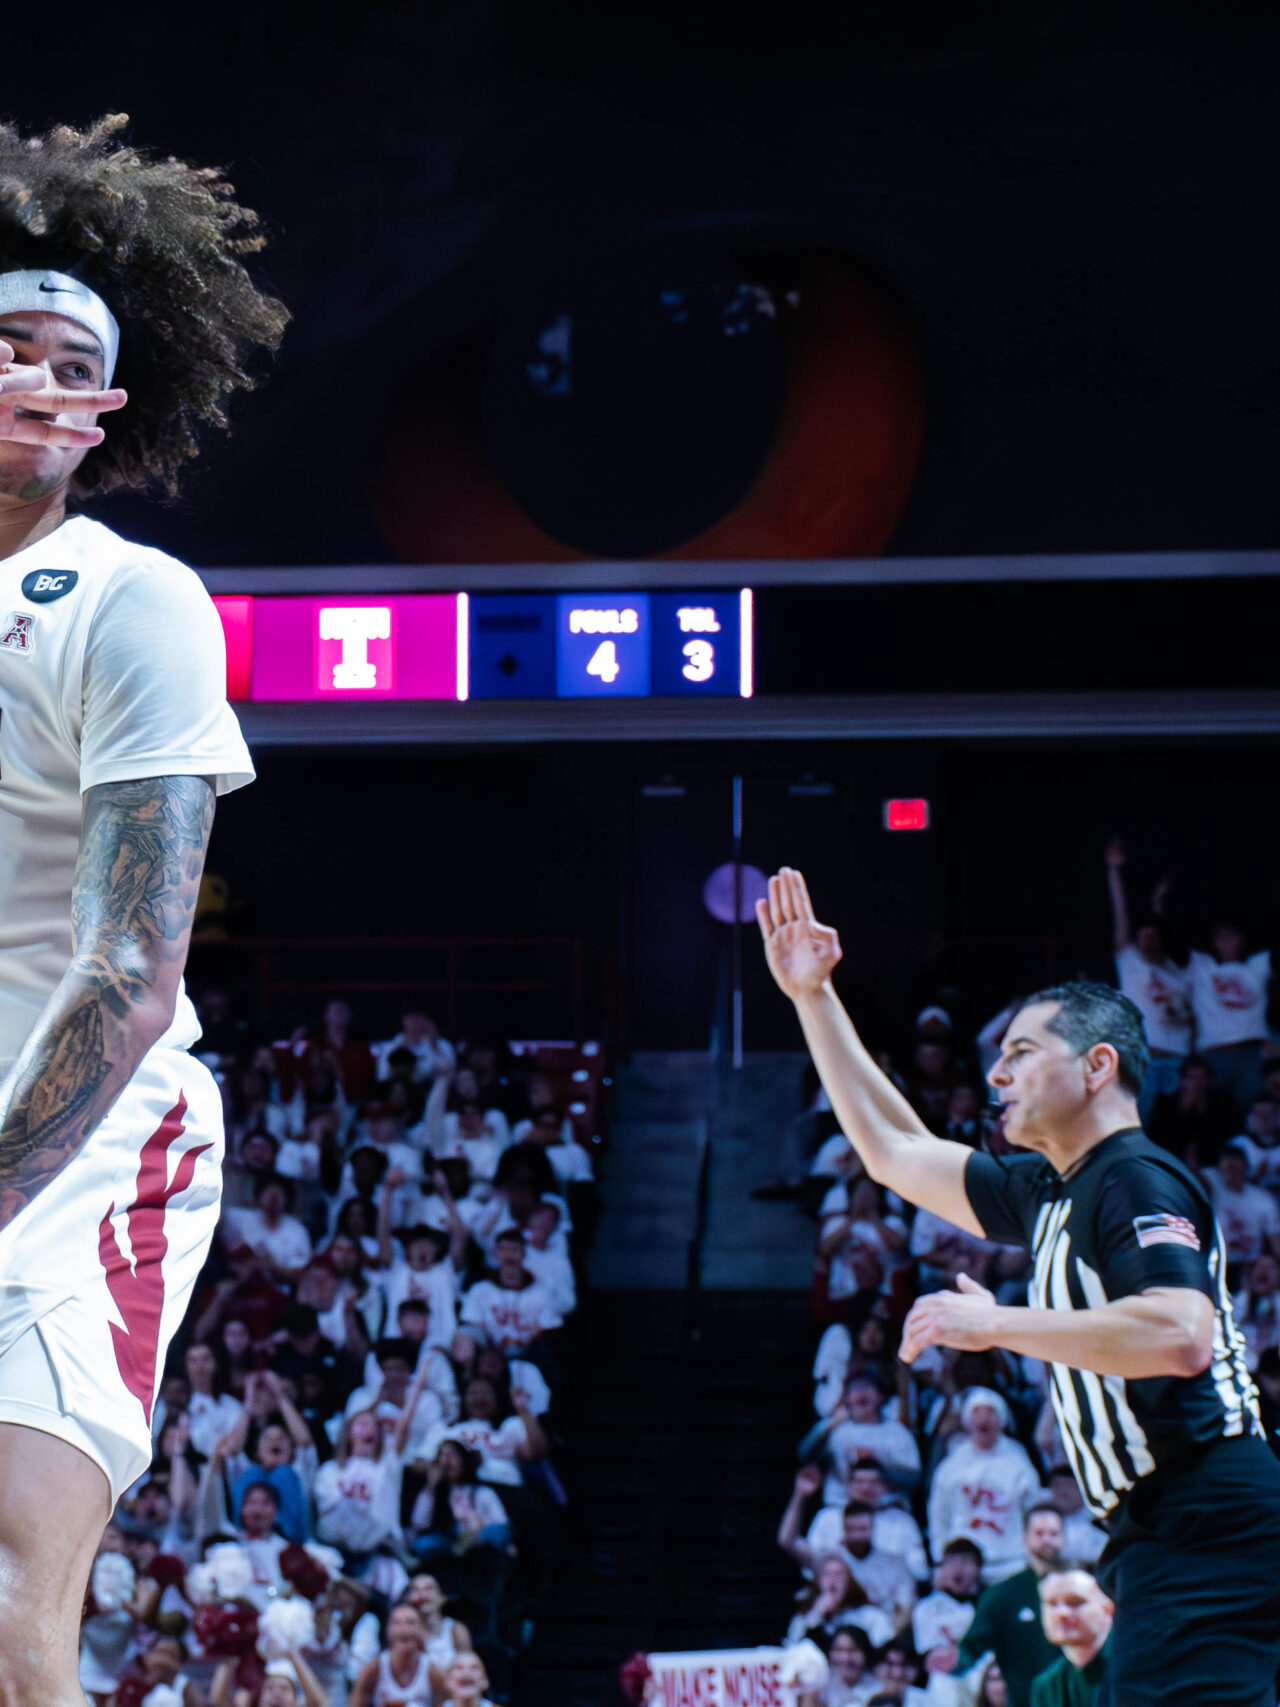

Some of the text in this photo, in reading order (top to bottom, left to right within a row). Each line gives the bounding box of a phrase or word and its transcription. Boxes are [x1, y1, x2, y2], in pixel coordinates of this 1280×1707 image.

[33, 574, 69, 592] BG
[569, 608, 639, 634] FOULS
[319, 606, 391, 689] T
[586, 640, 620, 683] 4
[682, 639, 714, 682] 3
[722, 1664, 780, 1707] NOISE
